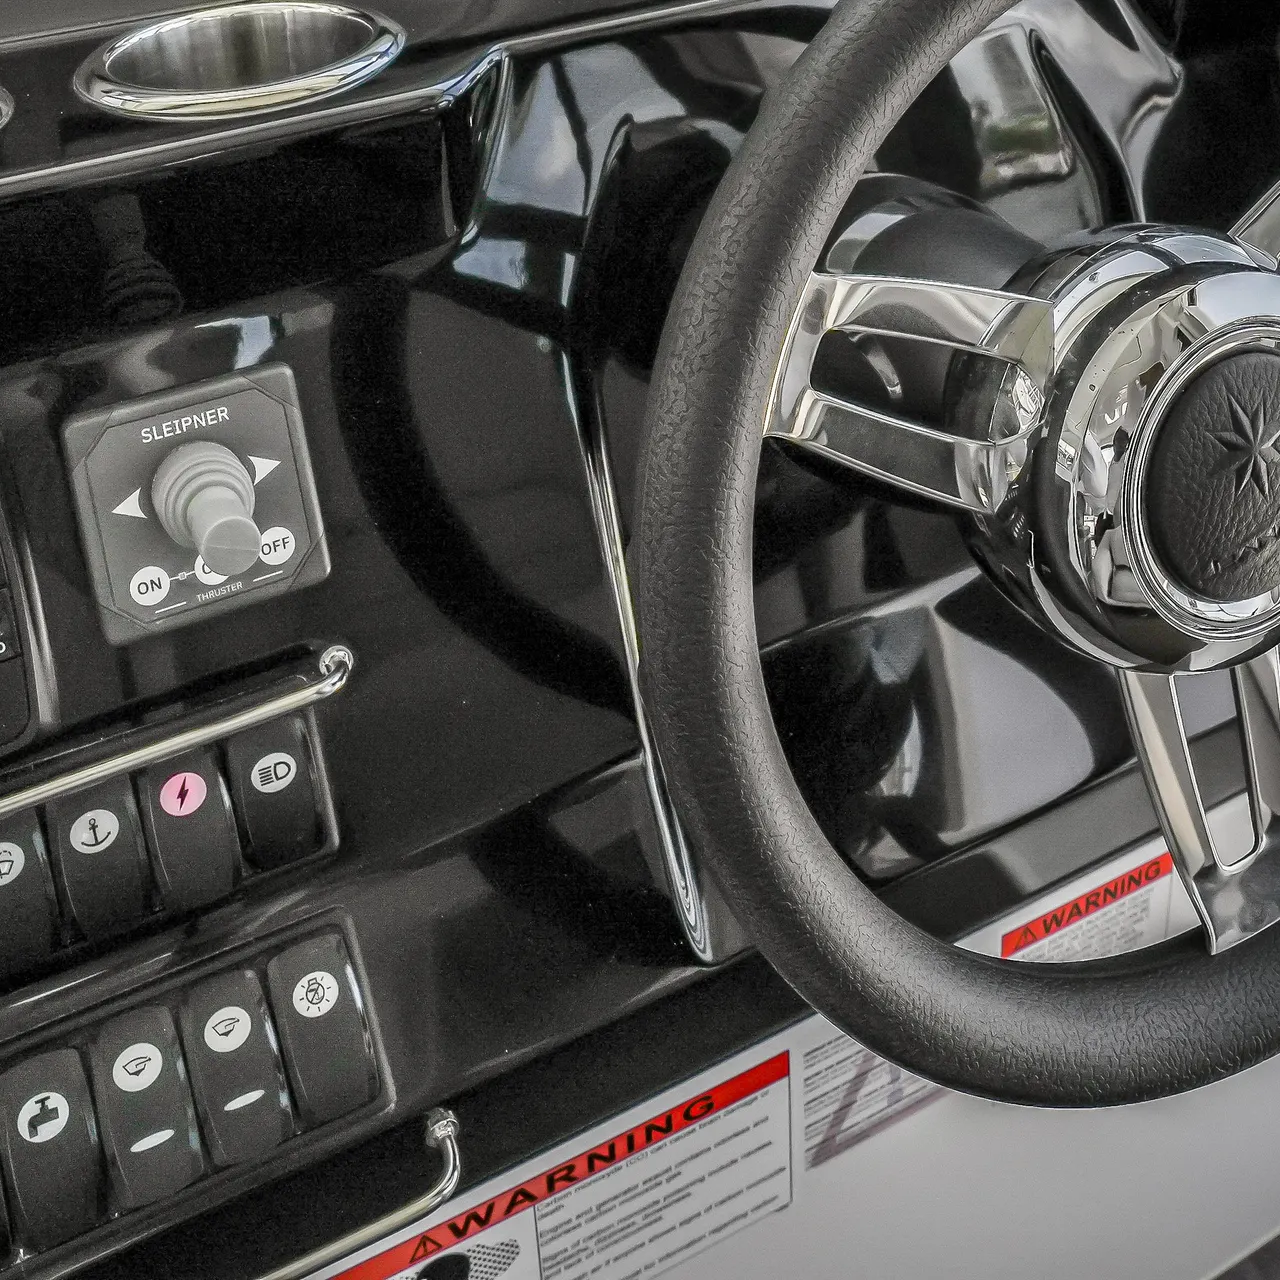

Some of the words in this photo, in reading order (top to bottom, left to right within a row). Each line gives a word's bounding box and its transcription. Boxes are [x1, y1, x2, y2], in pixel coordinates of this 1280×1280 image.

[141, 407, 229, 444] SLEIPNER
[261, 535, 291, 556] OFF
[136, 577, 163, 596] ON
[196, 581, 243, 603] THRUSTER
[1042, 860, 1163, 935] WARNING
[448, 1095, 715, 1239] WARNING
